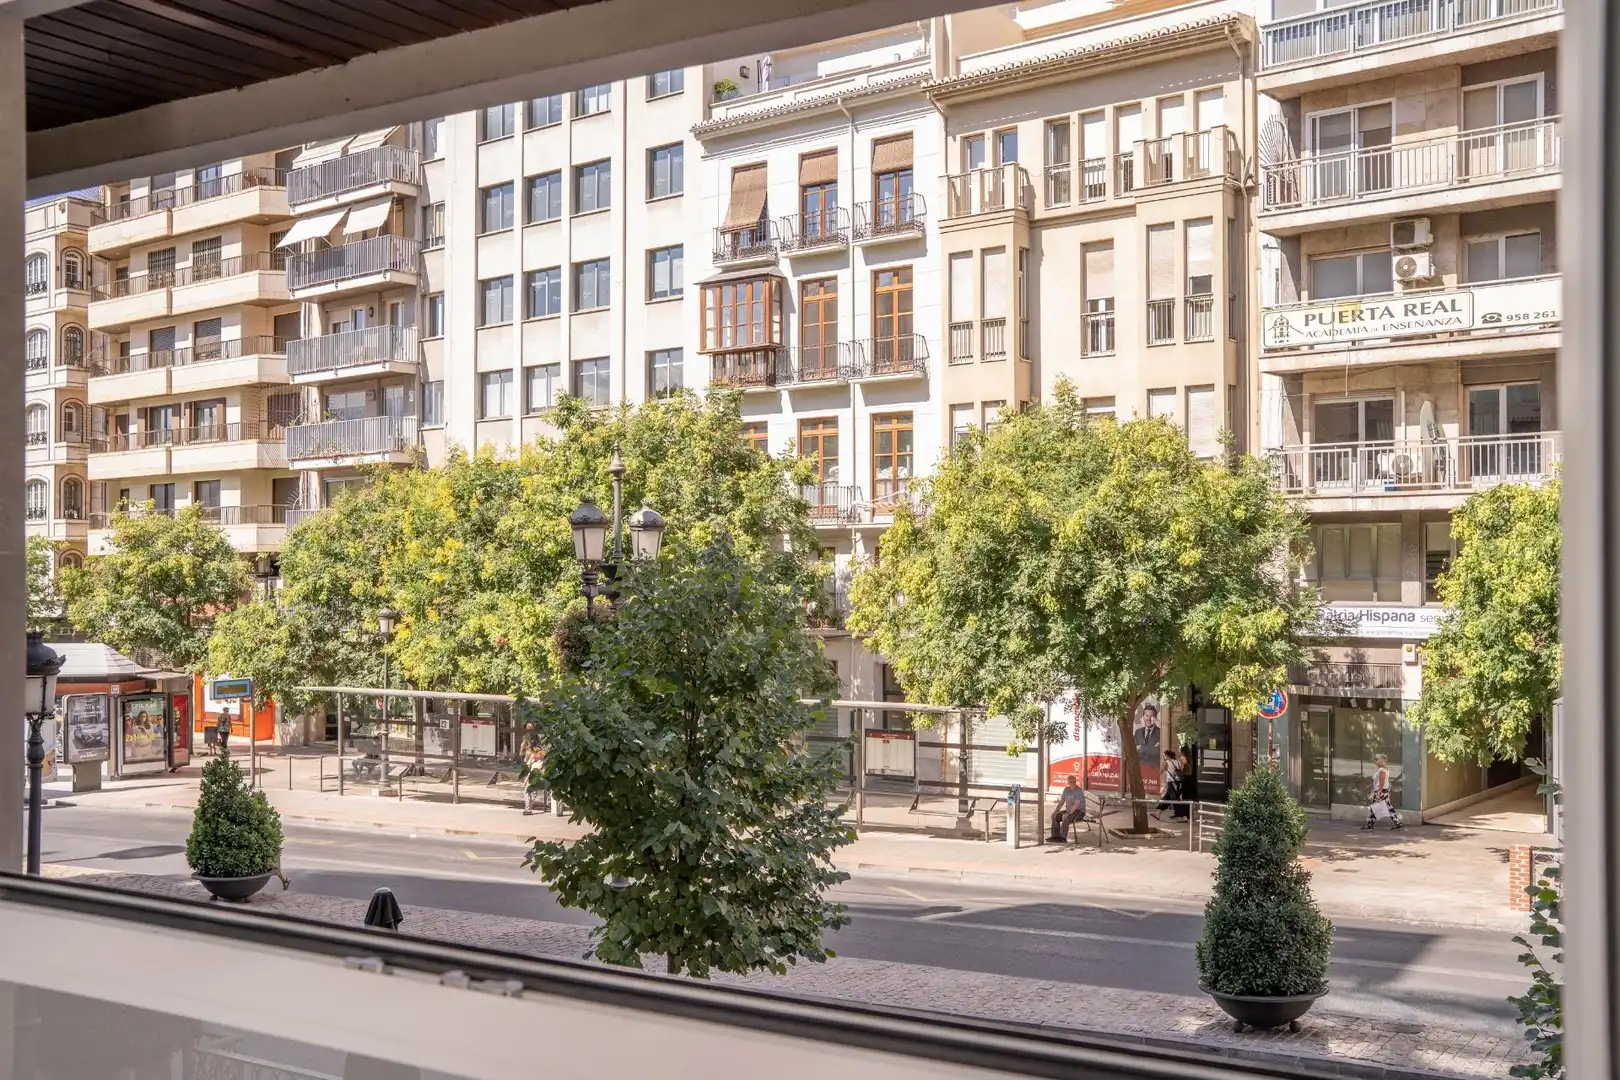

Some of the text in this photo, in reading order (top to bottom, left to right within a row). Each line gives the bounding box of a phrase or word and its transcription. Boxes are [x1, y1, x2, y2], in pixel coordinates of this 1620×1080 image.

[1304, 298, 1462, 327] PUERTA REAL
[1506, 310, 1558, 322] 958 261
[1360, 609, 1416, 624] Hispana
[1072, 692, 1081, 742] dispon
